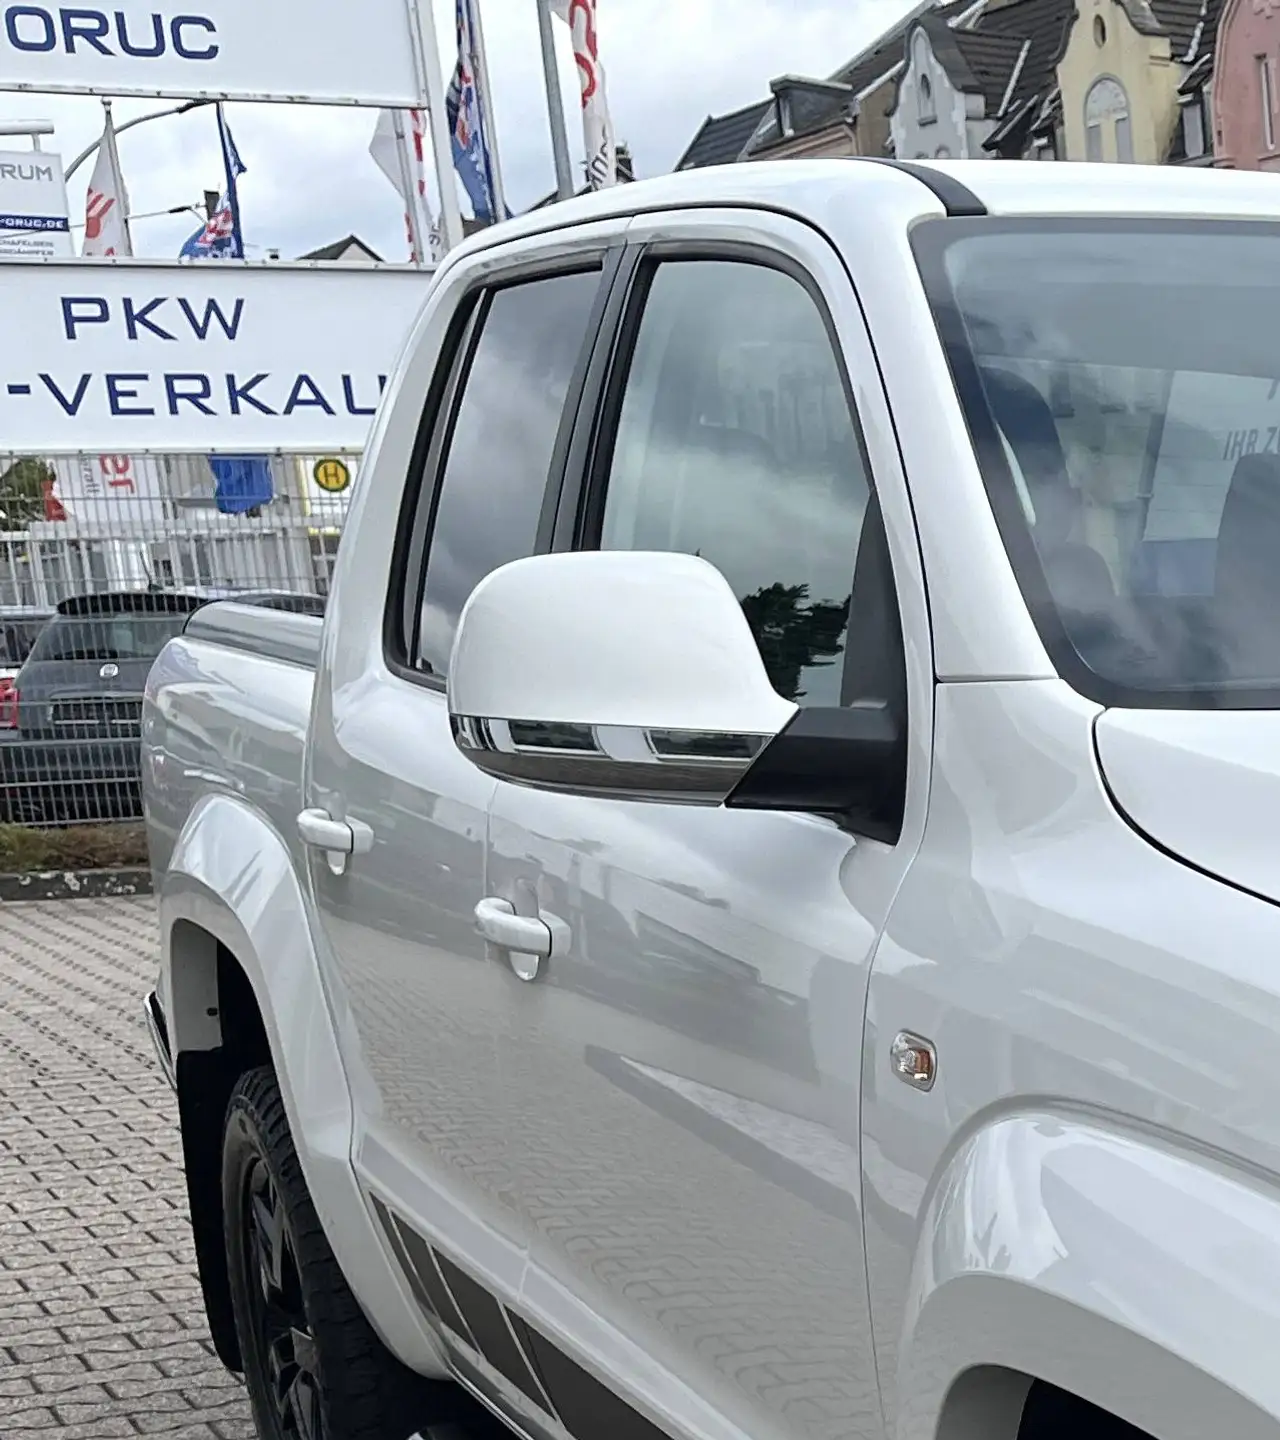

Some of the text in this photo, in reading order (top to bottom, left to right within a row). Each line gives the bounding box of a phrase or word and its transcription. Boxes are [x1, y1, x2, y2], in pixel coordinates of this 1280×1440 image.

[5, 5, 219, 60] ORUC
[60, 296, 245, 341] PKW
[1223, 428, 1259, 461] IHR
